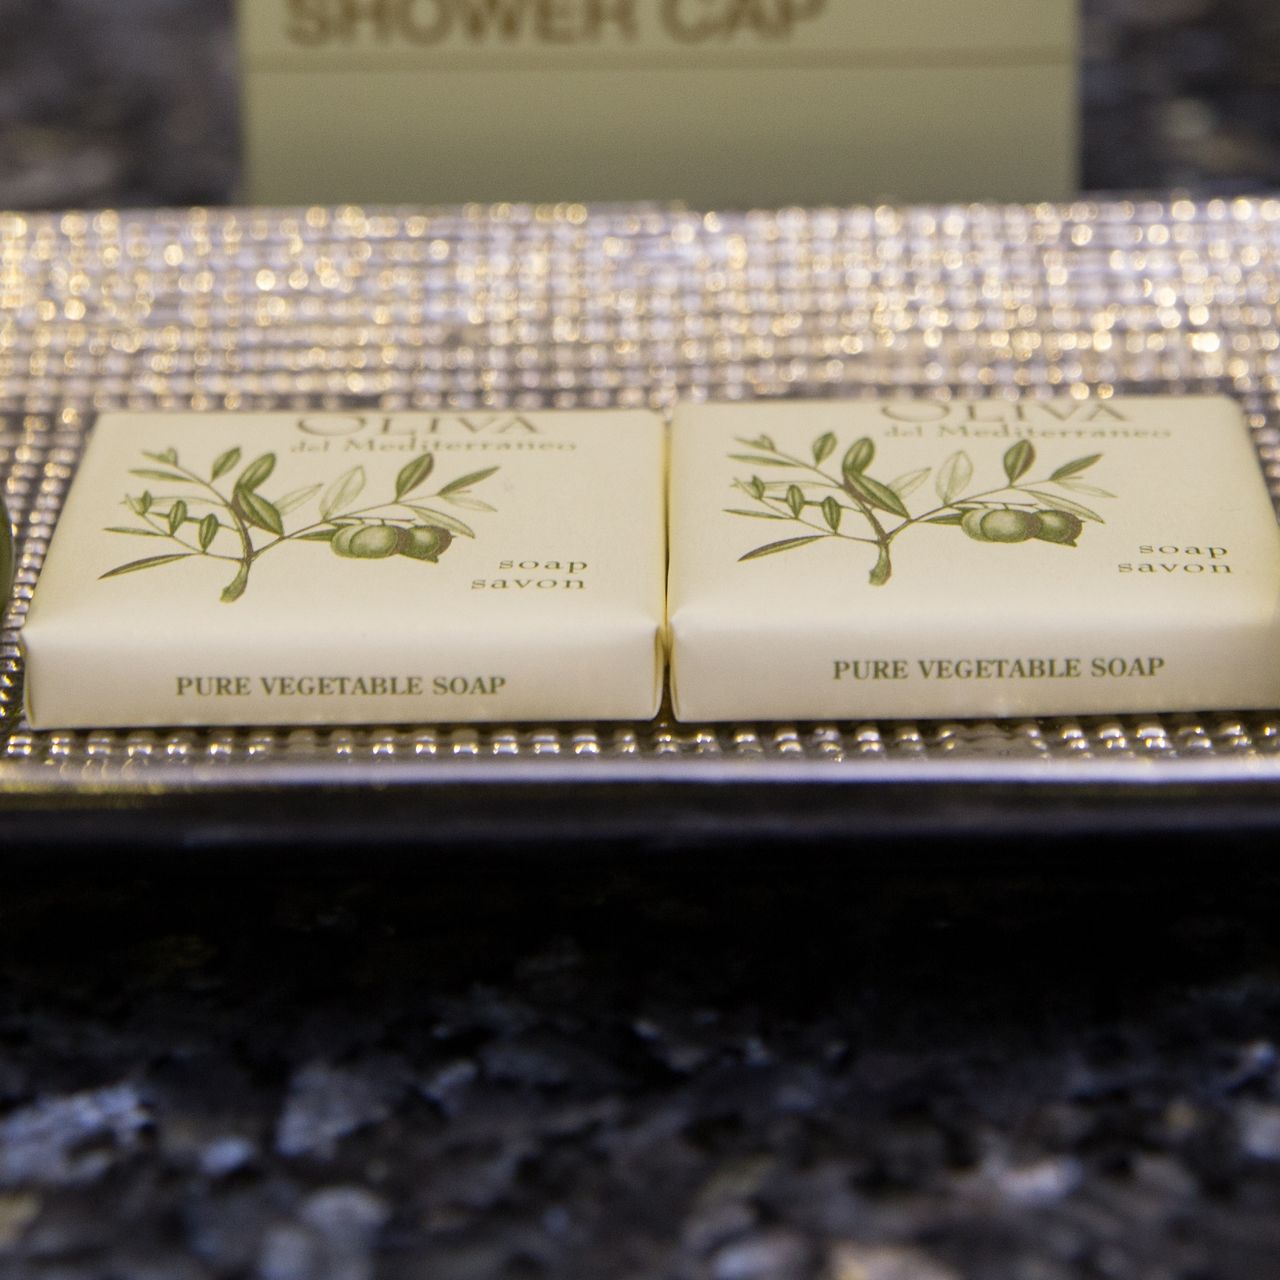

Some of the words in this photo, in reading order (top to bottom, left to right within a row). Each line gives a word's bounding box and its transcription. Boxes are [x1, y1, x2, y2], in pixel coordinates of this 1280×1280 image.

[881, 403, 1128, 422] OLIVA
[296, 416, 542, 436] OLIVA
[884, 423, 923, 438] del
[291, 438, 330, 453] del
[1139, 545, 1228, 559] soap
[499, 560, 588, 574] soap
[1118, 563, 1233, 573] savon
[471, 579, 585, 589] savon
[832, 659, 909, 680] PURE
[916, 657, 1082, 679] VEGETABLE
[1090, 656, 1166, 677] SOAP
[175, 675, 251, 697] PURE
[259, 675, 424, 696] VEGETABLE
[432, 675, 506, 696] SOAP
